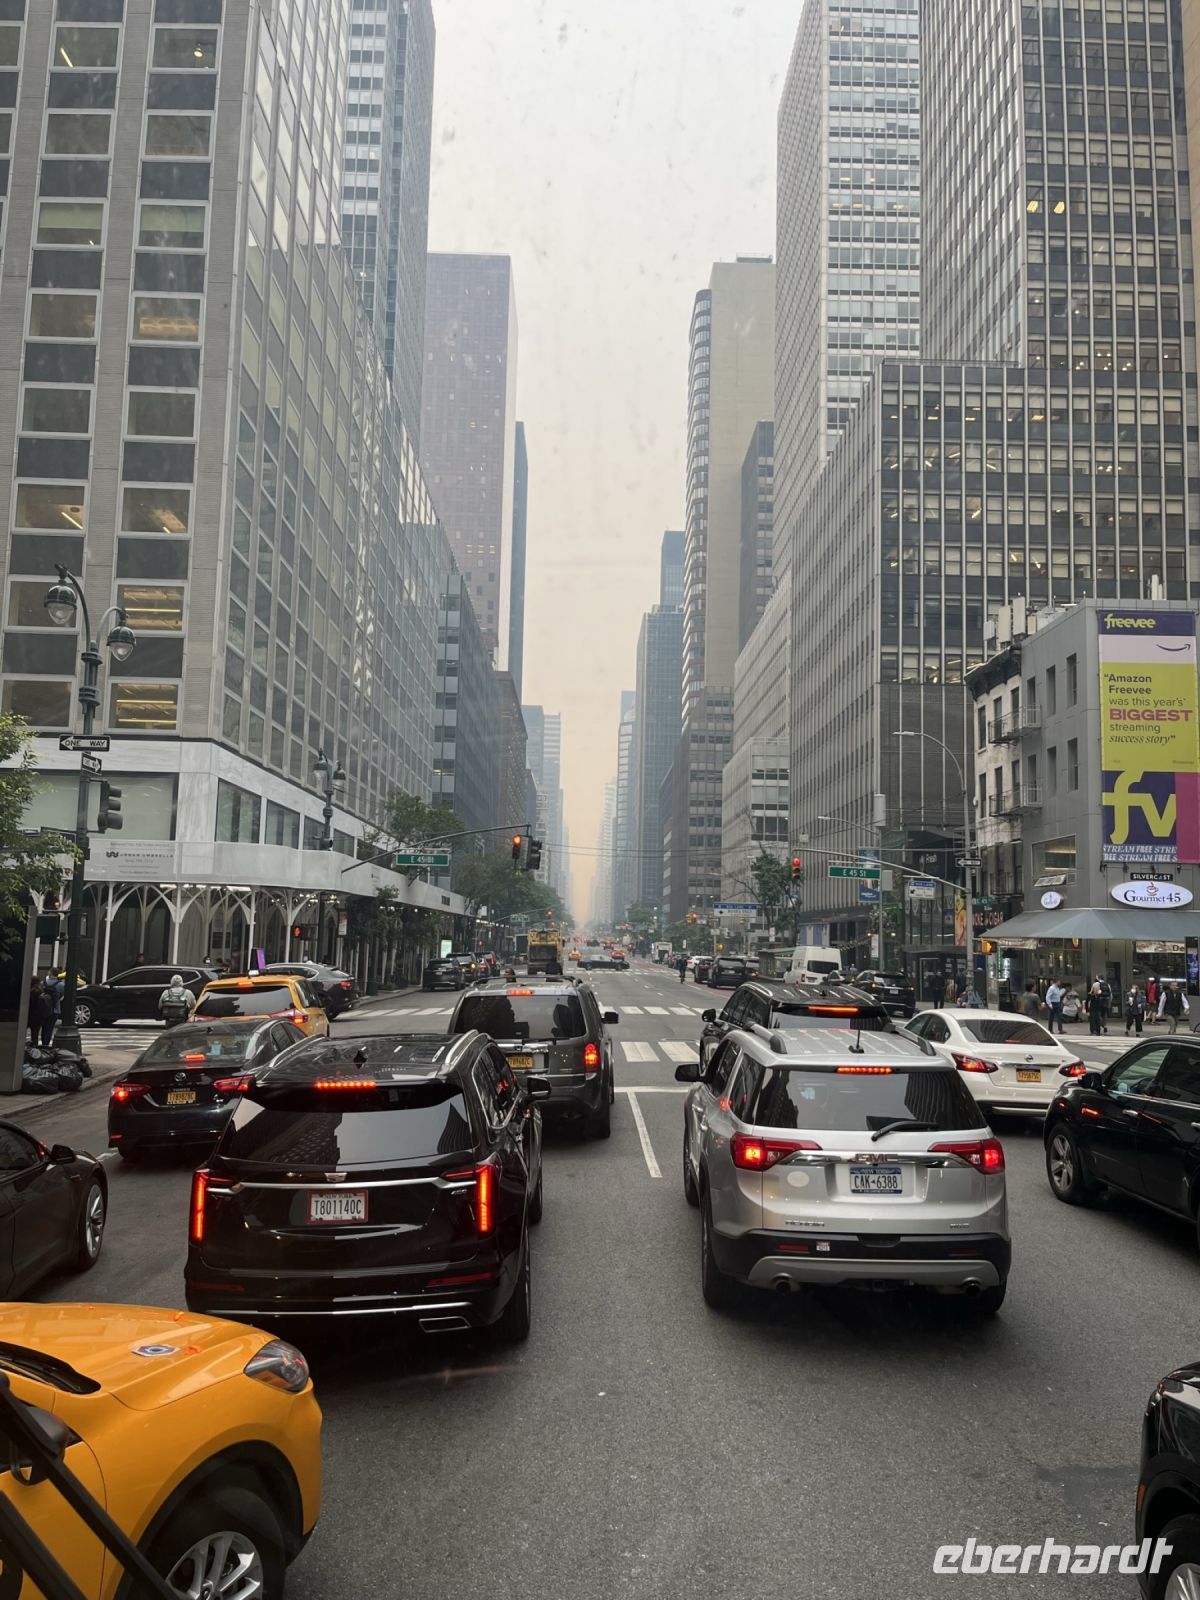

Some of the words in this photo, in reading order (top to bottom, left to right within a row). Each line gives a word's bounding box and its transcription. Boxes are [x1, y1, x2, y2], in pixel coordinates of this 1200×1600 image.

[1104, 613, 1156, 629] freevee
[1108, 685, 1152, 694] Freevee
[1132, 697, 1150, 706] this
[1109, 708, 1192, 721] BIGGEST
[1109, 723, 1161, 734] streaming
[1109, 735, 1144, 744] success
[1136, 845, 1153, 853] FREE
[410, 855, 415, 863] E
[849, 869, 858, 877] 45
[1124, 890, 1166, 903] Gourmet
[1166, 892, 1181, 903] 45
[313, 1200, 362, 1216] T801140C
